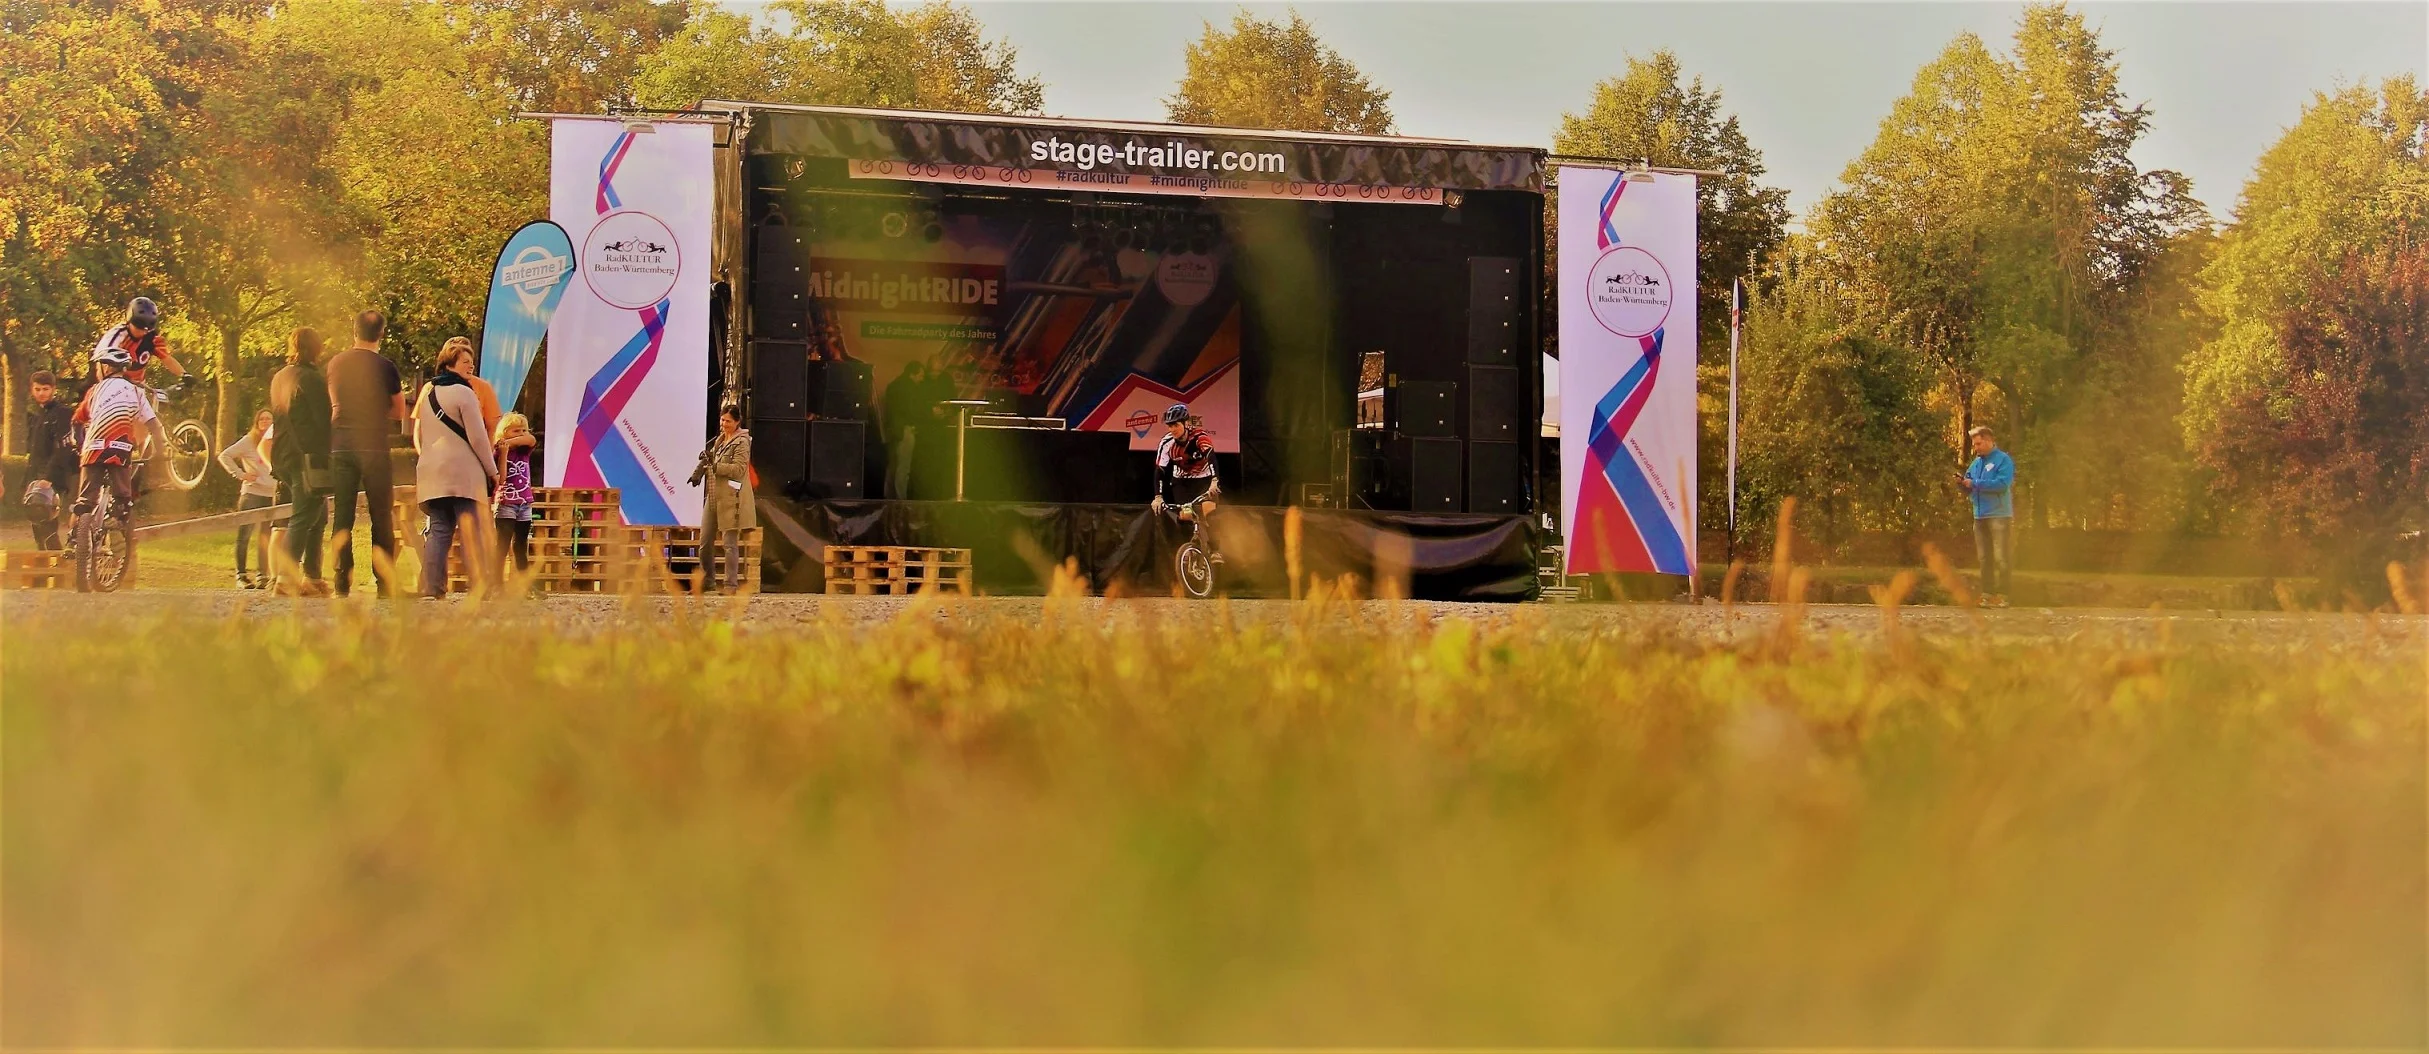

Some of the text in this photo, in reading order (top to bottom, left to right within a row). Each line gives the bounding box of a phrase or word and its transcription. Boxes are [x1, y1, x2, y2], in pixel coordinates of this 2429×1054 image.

[1030, 136, 1285, 173] stage-trailer.com
[1056, 170, 1248, 192] #radkultur #midnightride
[606, 254, 661, 263] RadKULTUR
[504, 263, 556, 281] antenne
[594, 264, 675, 276] Baden-Württemberg
[1608, 286, 1656, 295] RadKULTUR
[1598, 295, 1668, 307] Baden-Württemberg
[869, 325, 885, 335] Die
[950, 327, 966, 338] des
[967, 328, 997, 339] Jahres
[622, 418, 676, 496] www.radkultur-bw.de
[1629, 437, 1676, 511] www.radkultur-bw.de
